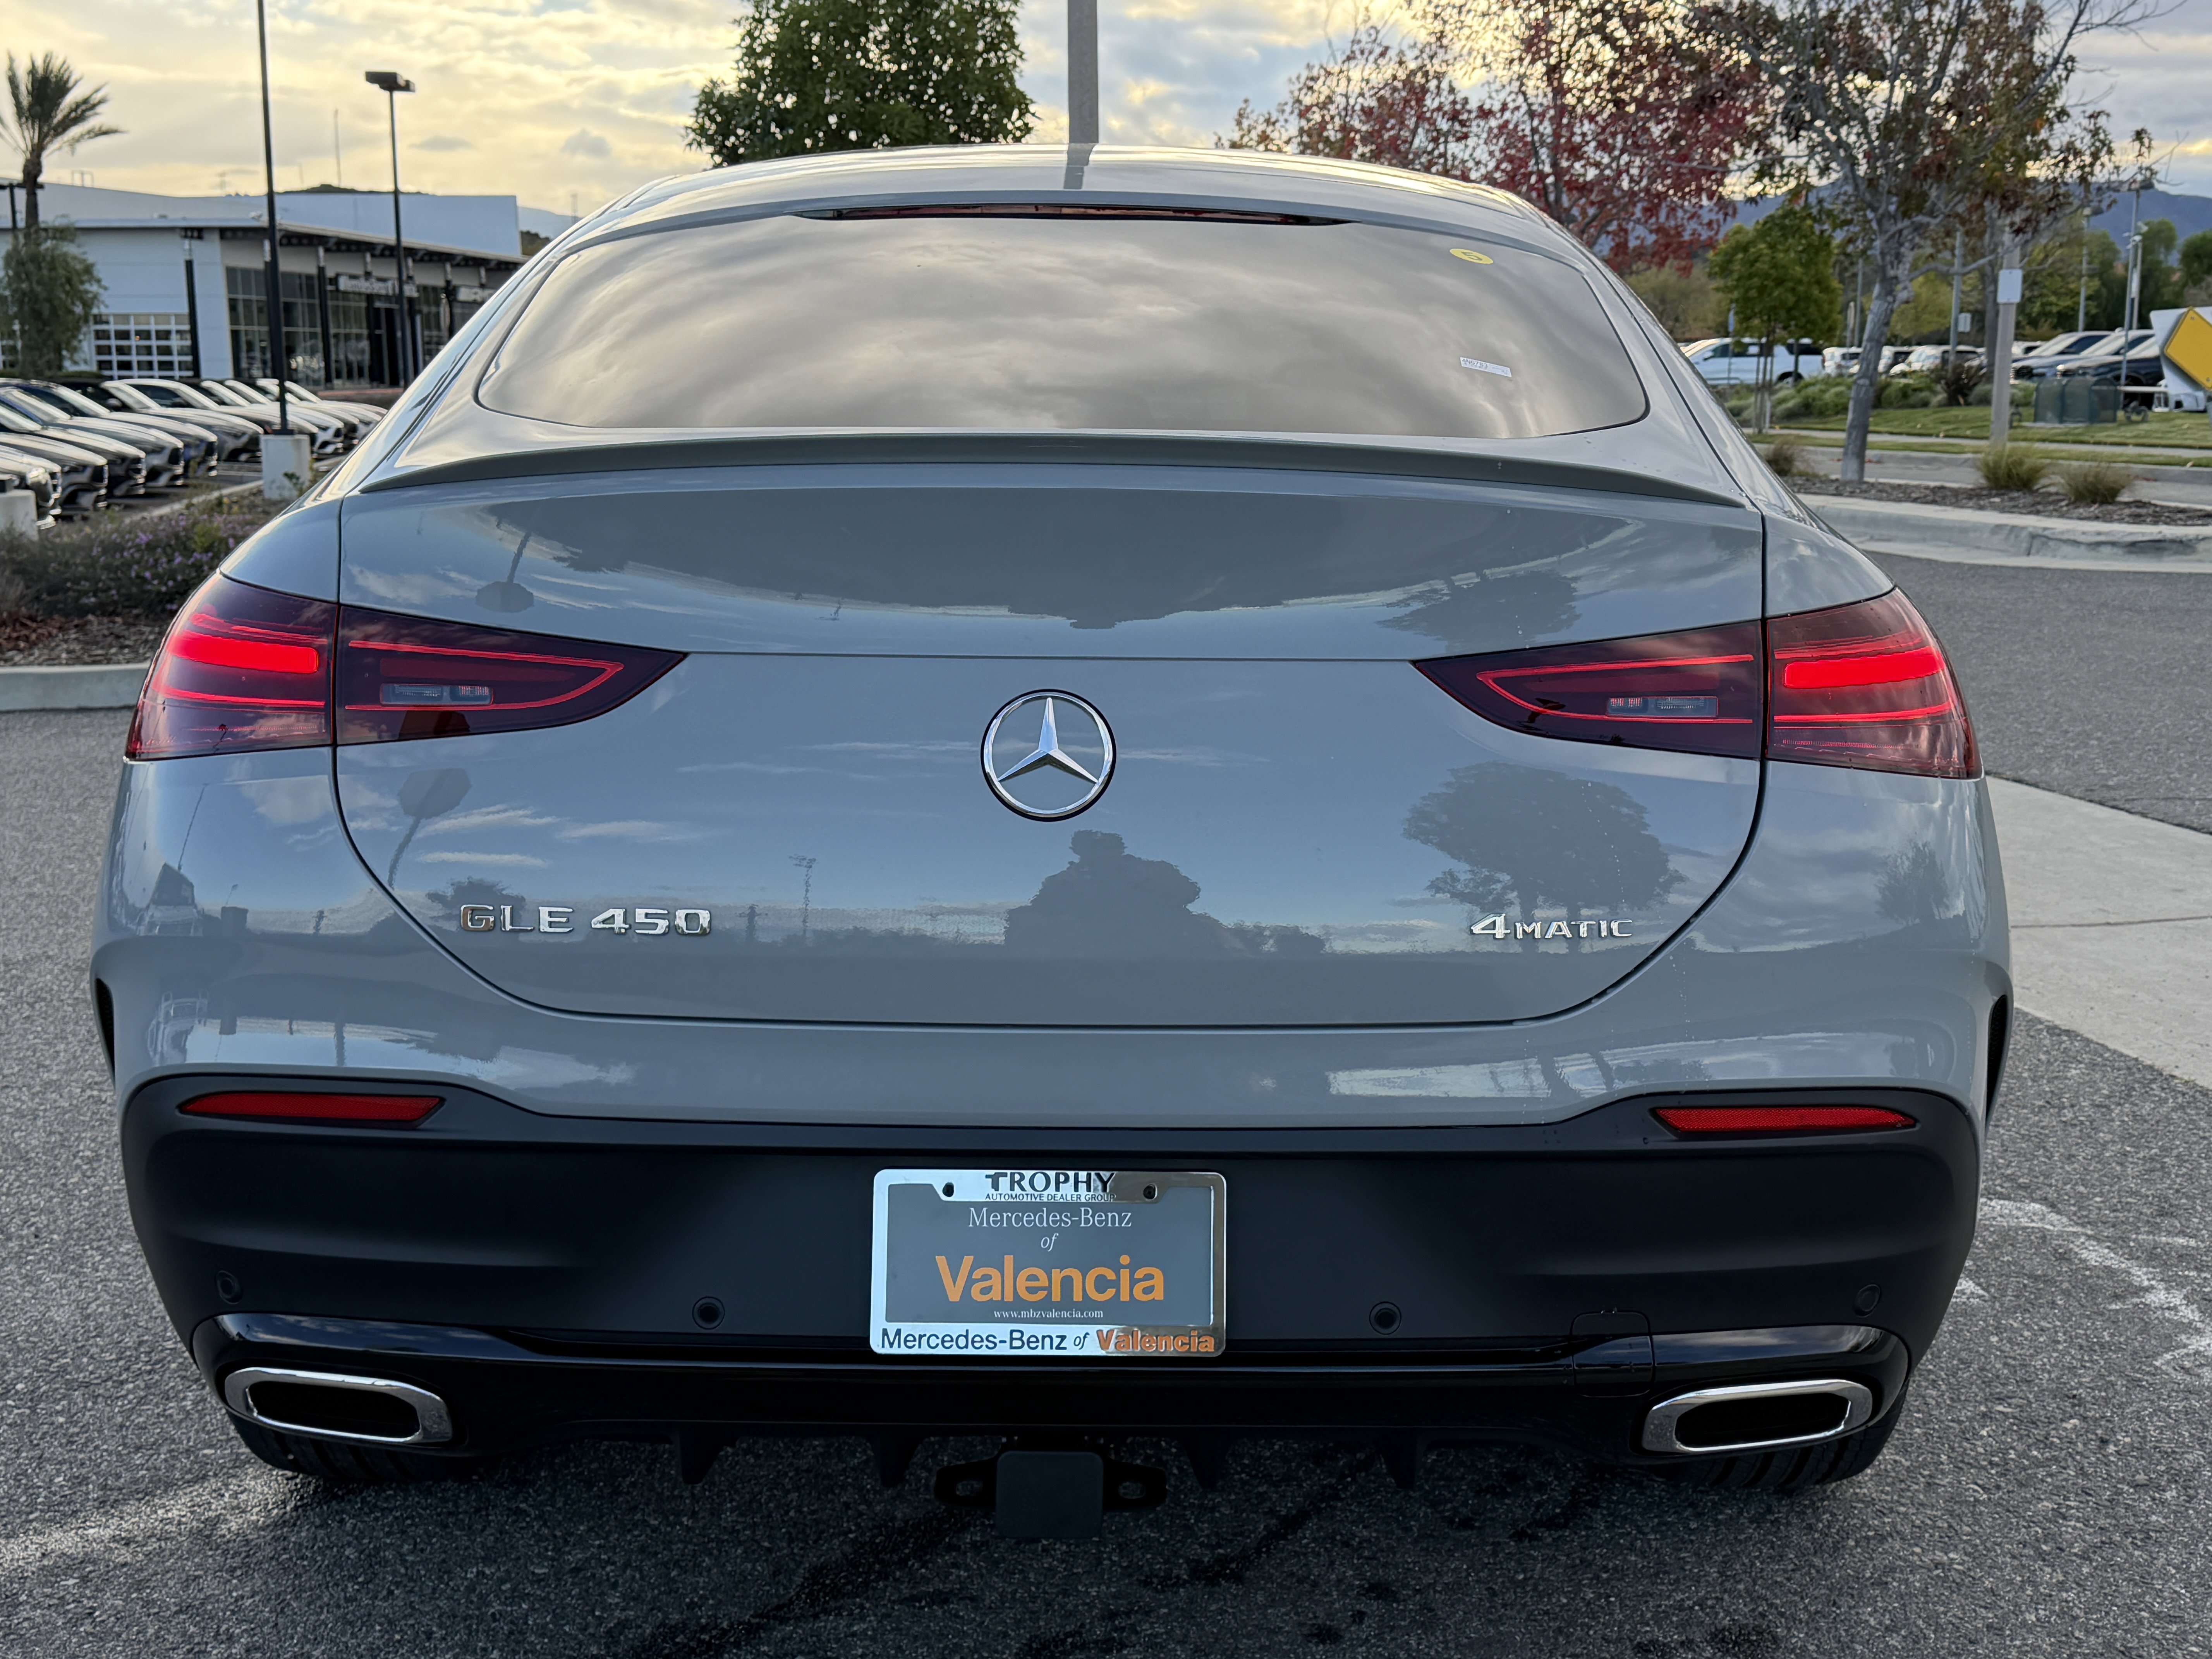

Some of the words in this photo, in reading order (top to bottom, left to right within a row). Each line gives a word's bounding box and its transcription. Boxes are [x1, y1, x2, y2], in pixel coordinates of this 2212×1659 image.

[460, 904, 574, 932] GLE
[591, 908, 711, 934] 450
[985, 1171, 1116, 1193] TROPHY
[1047, 1194, 1082, 1202] DEALER
[1084, 1194, 1116, 1202] GROUP
[968, 1207, 1132, 1227] Mercedes-Benz
[1041, 1233, 1059, 1252] of
[935, 1255, 1164, 1302] Valencia
[994, 1308, 1104, 1318] www.mbzvalencia.com
[881, 1328, 1067, 1350] Mercedes-Benz
[1073, 1332, 1090, 1350] of
[1096, 1329, 1215, 1353] Valencia
